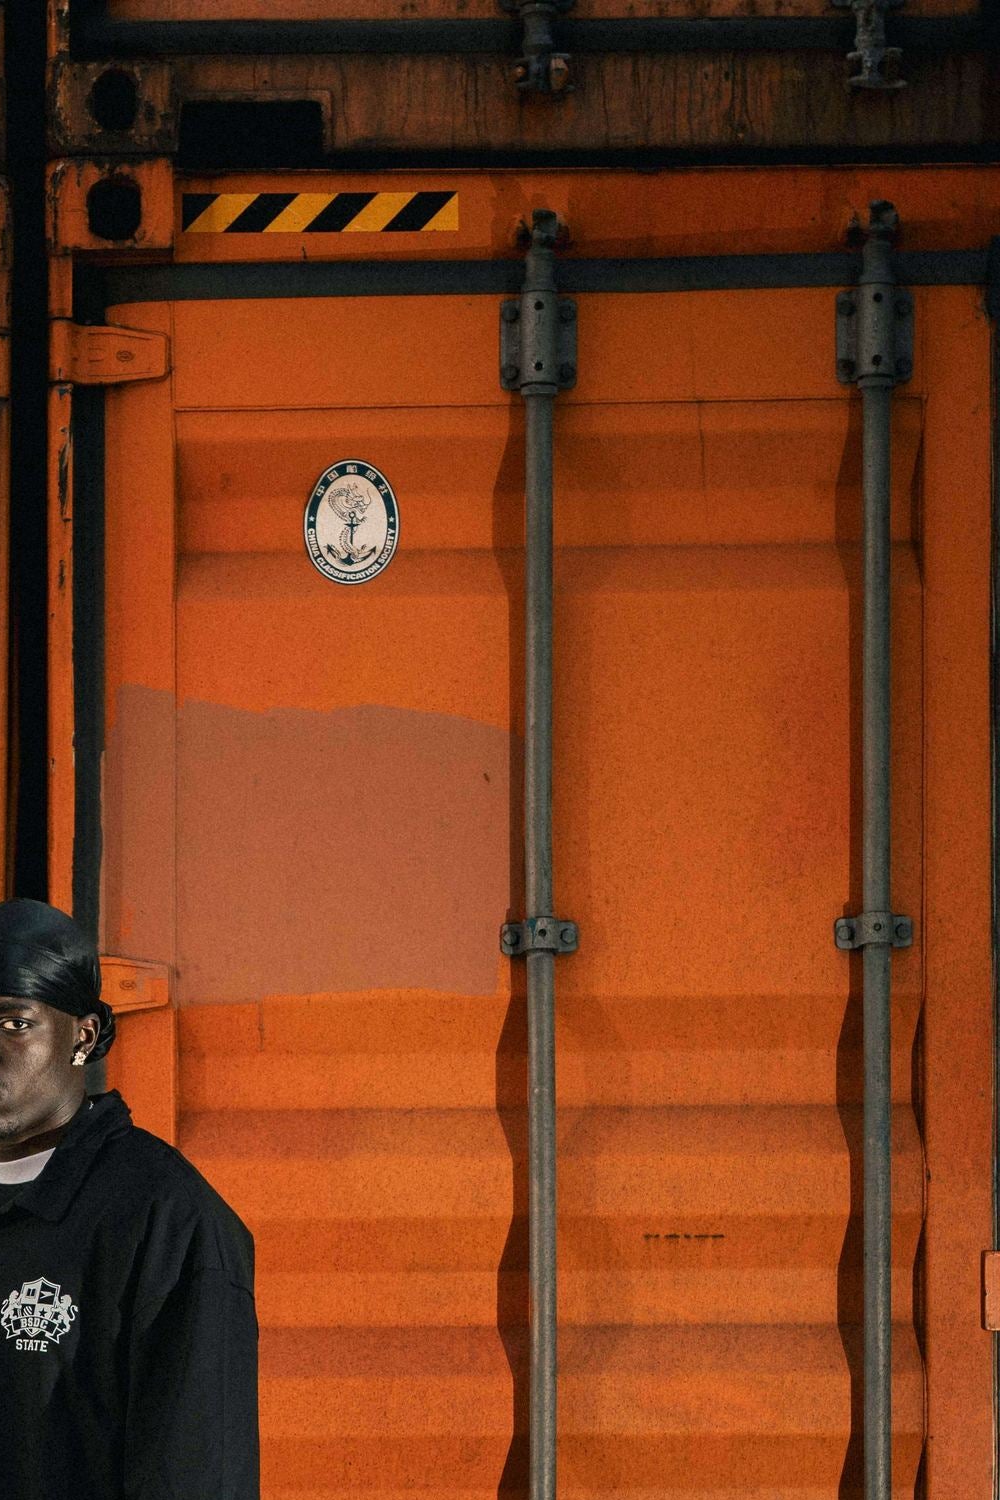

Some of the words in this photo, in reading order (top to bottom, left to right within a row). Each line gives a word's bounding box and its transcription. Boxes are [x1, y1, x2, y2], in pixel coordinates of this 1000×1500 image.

[307, 527, 318, 556] CHINA
[316, 557, 381, 581] CLASSIFICATION
[379, 528, 396, 563] SOCIETY
[20, 1317, 49, 1330] BSDC
[15, 1338, 49, 1353] STATE
